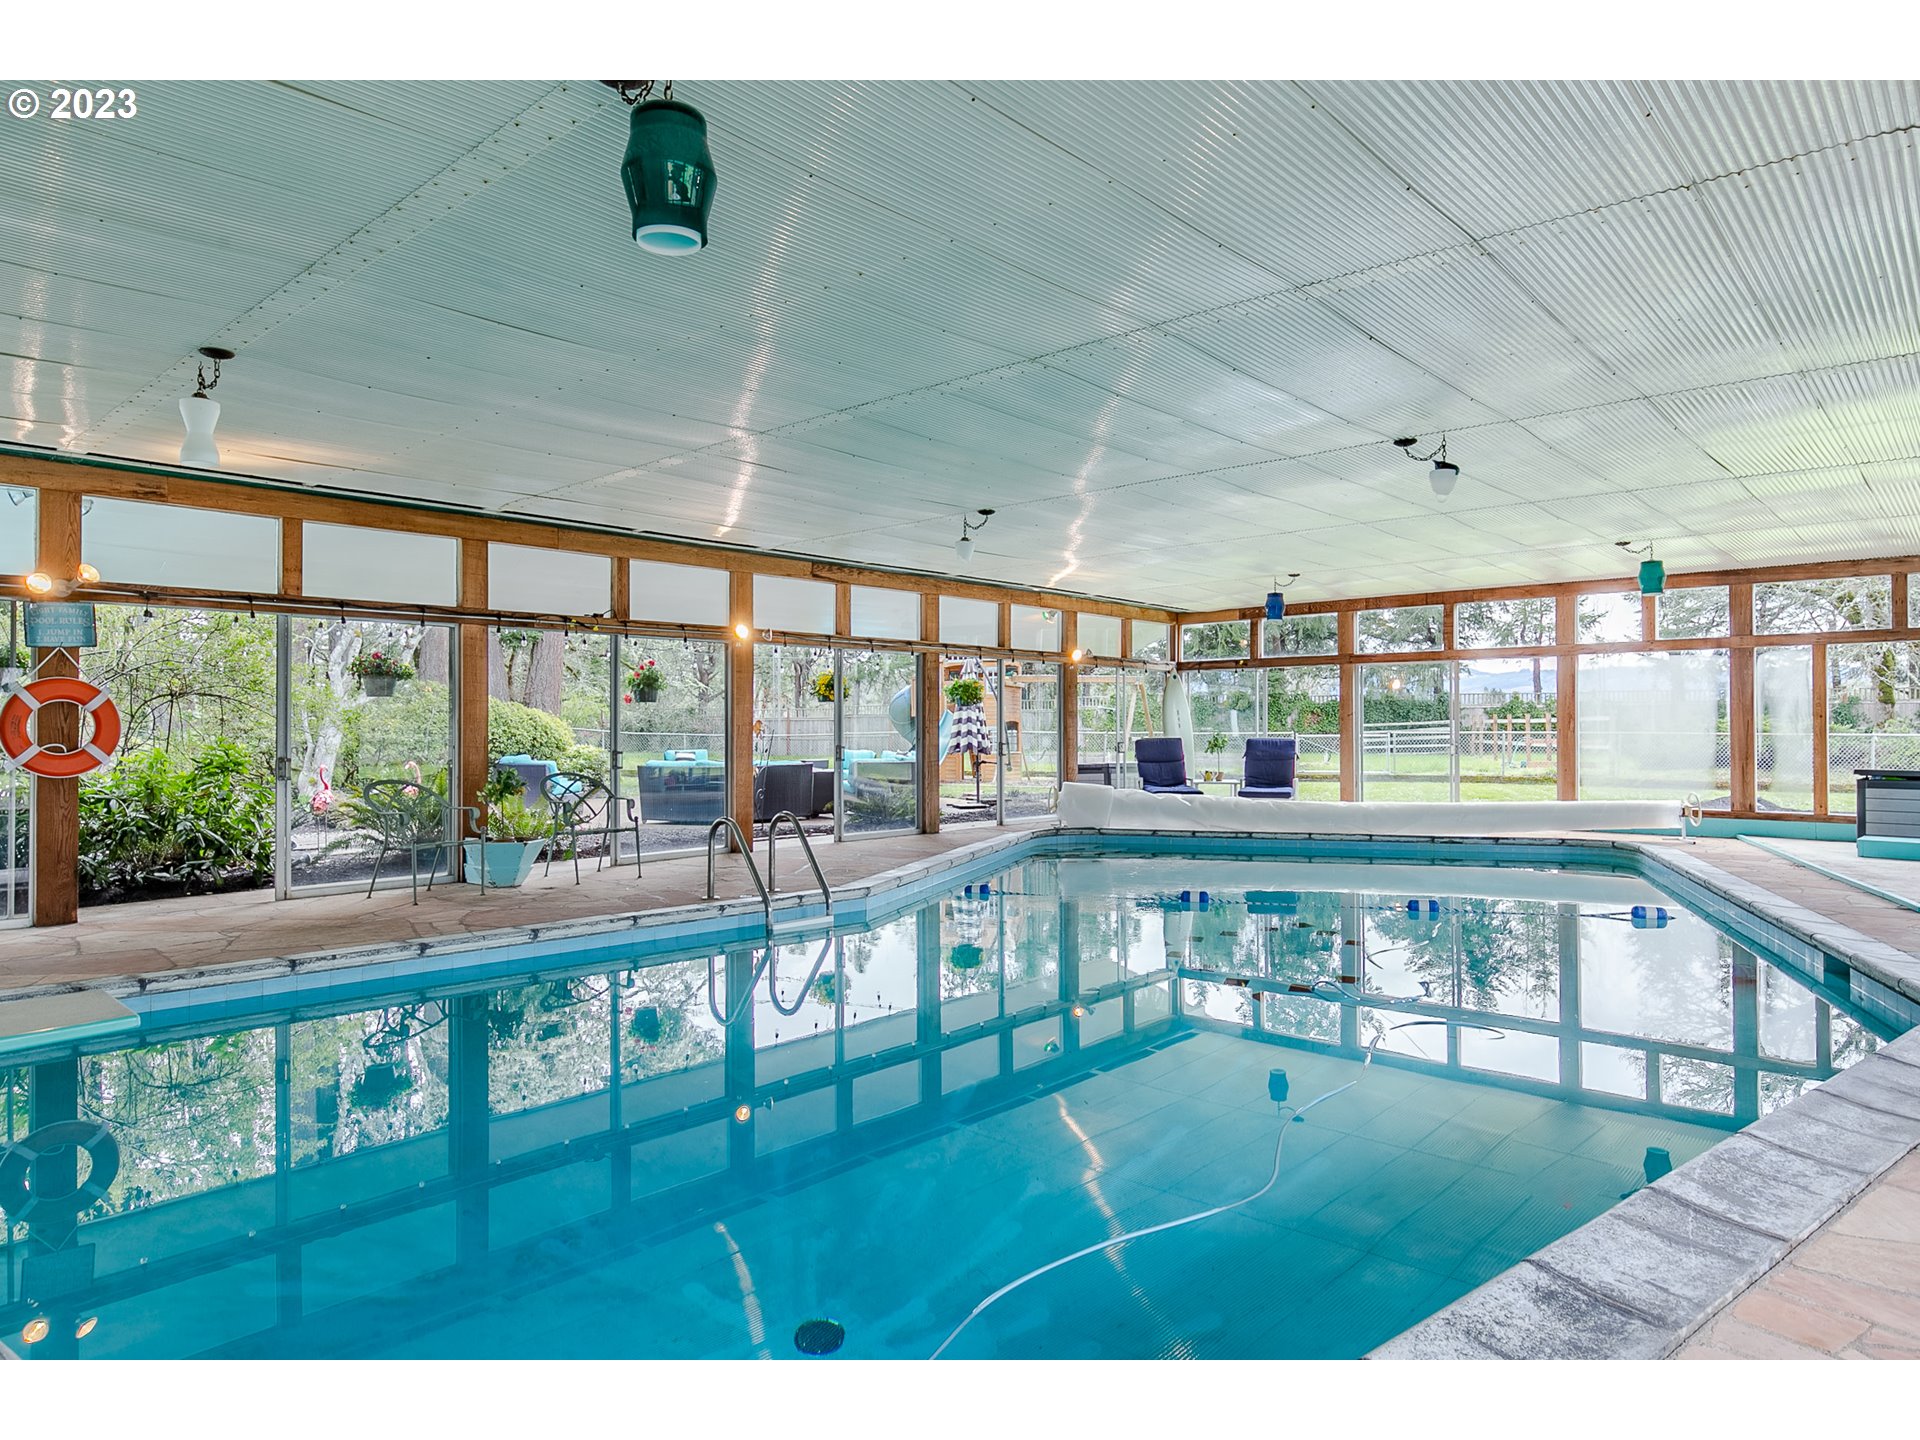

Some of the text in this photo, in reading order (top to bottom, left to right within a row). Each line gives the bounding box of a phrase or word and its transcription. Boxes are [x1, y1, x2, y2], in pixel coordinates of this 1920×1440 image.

[58, 607, 89, 617] FAMILY
[30, 617, 91, 627] POOL RULES
